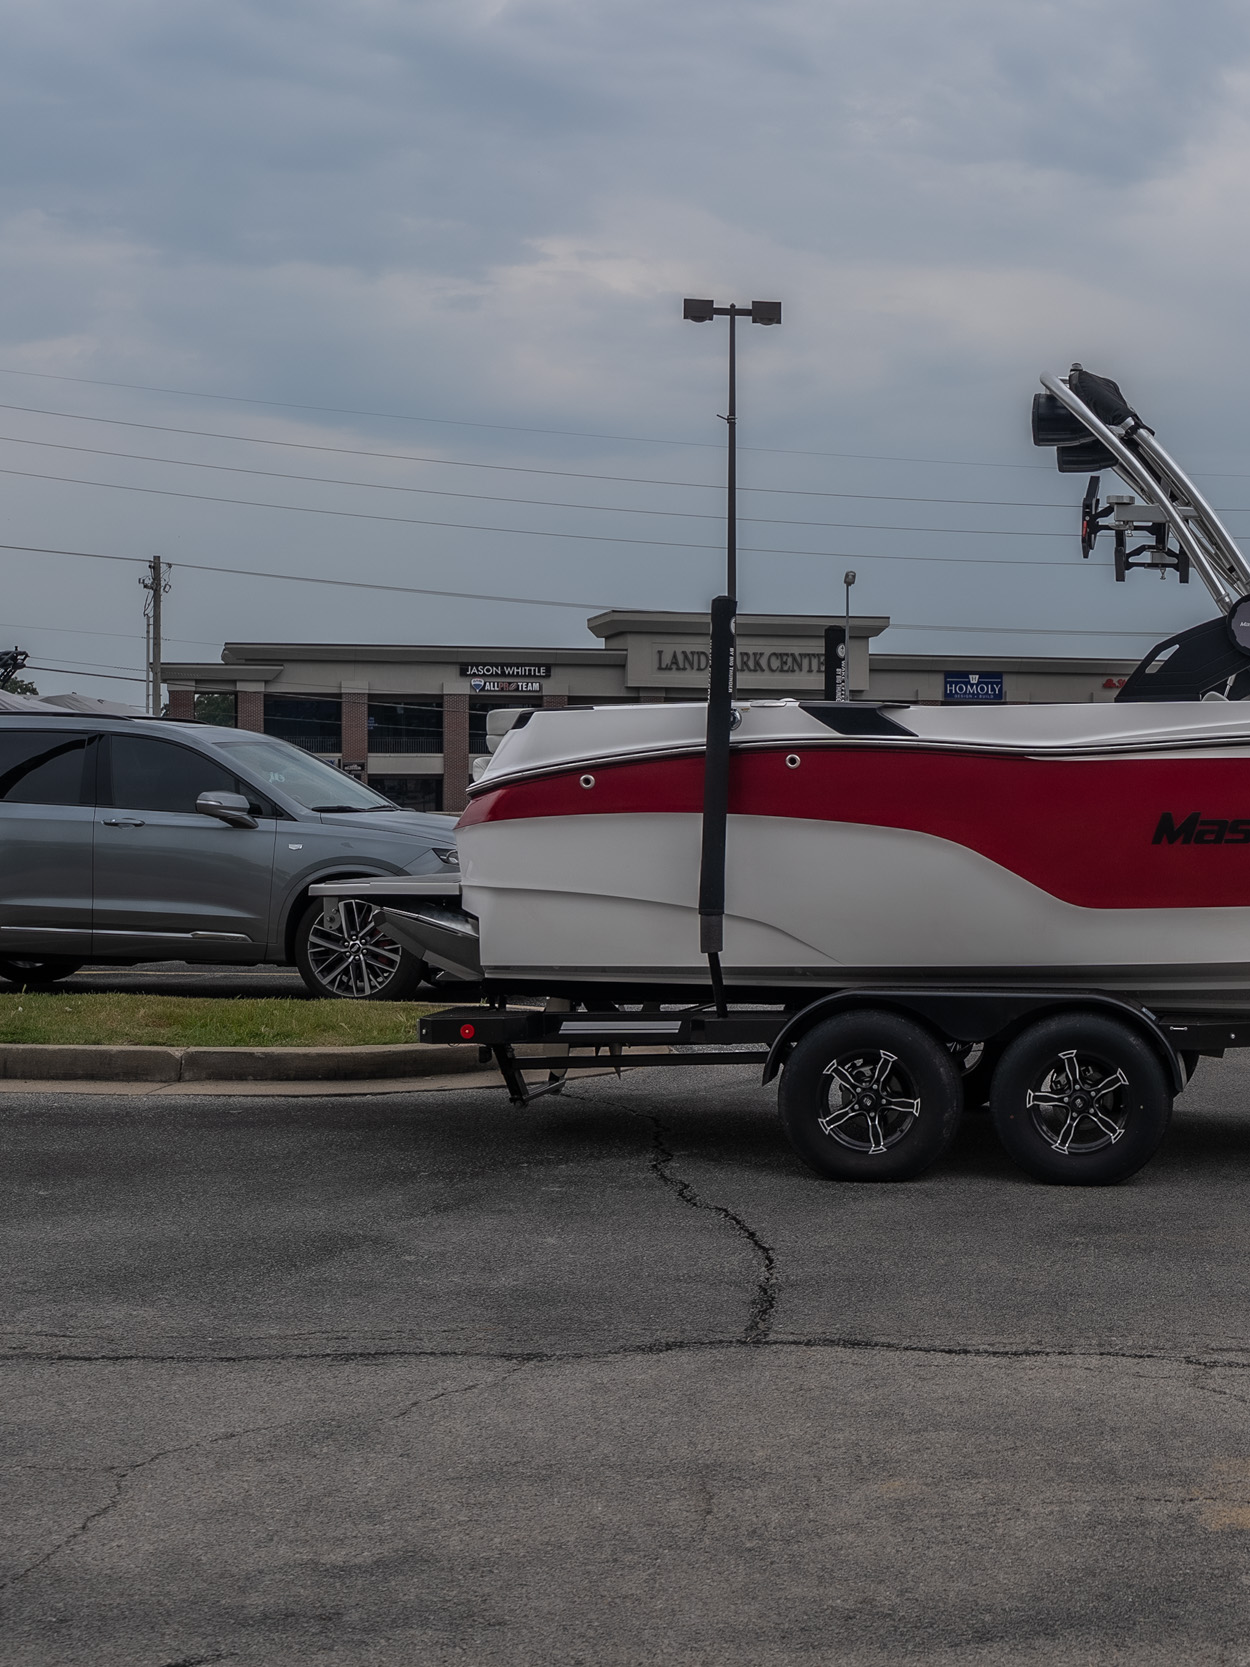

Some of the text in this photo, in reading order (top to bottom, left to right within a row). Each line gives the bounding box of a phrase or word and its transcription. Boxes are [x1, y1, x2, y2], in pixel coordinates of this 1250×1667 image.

[656, 649, 825, 673] LANDRK CENTE
[466, 665, 546, 676] JASON WHITTLE
[517, 682, 540, 691] TEAM
[946, 683, 1001, 694] HOMOLY
